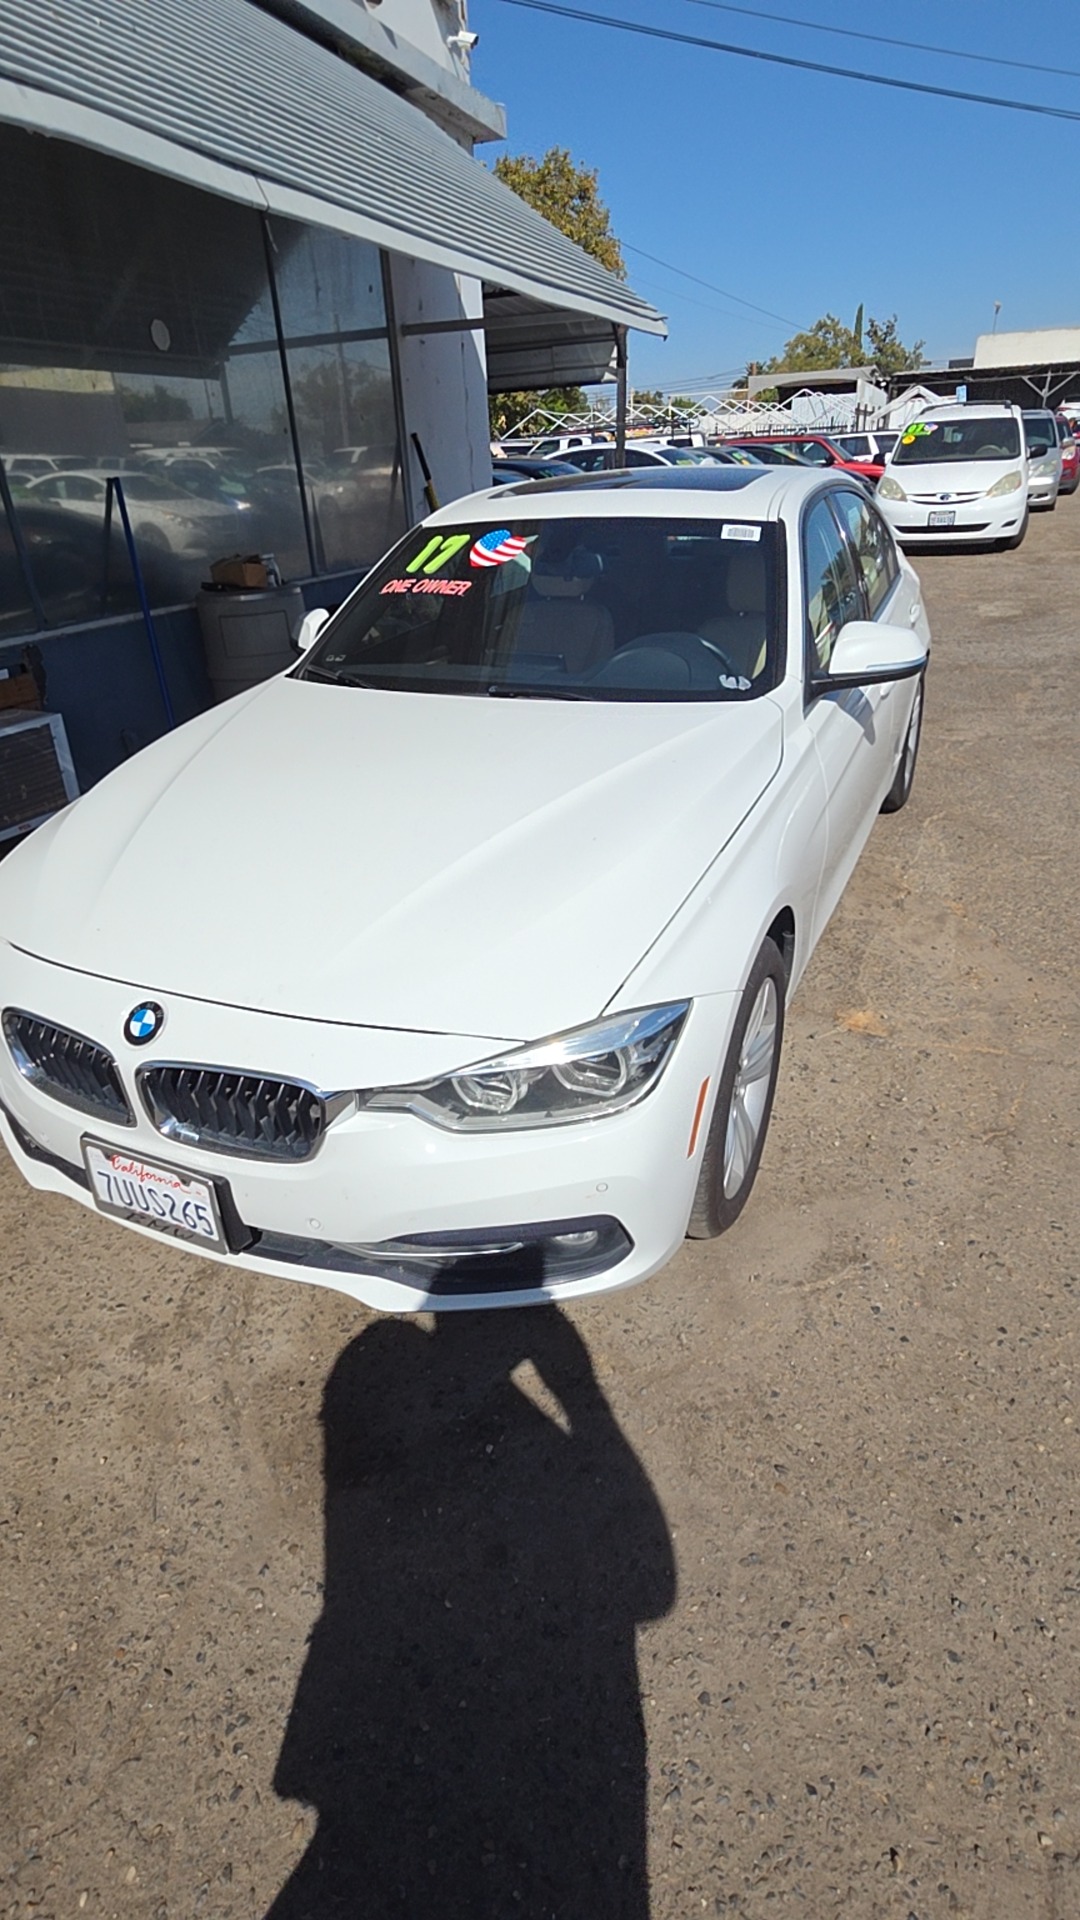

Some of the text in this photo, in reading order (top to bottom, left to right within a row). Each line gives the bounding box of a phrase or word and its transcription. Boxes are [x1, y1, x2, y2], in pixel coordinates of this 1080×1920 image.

[405, 533, 471, 575] 17
[379, 578, 472, 597] ONE OWNER
[111, 1154, 191, 1194] California
[97, 1171, 214, 1235] 7UUS265
